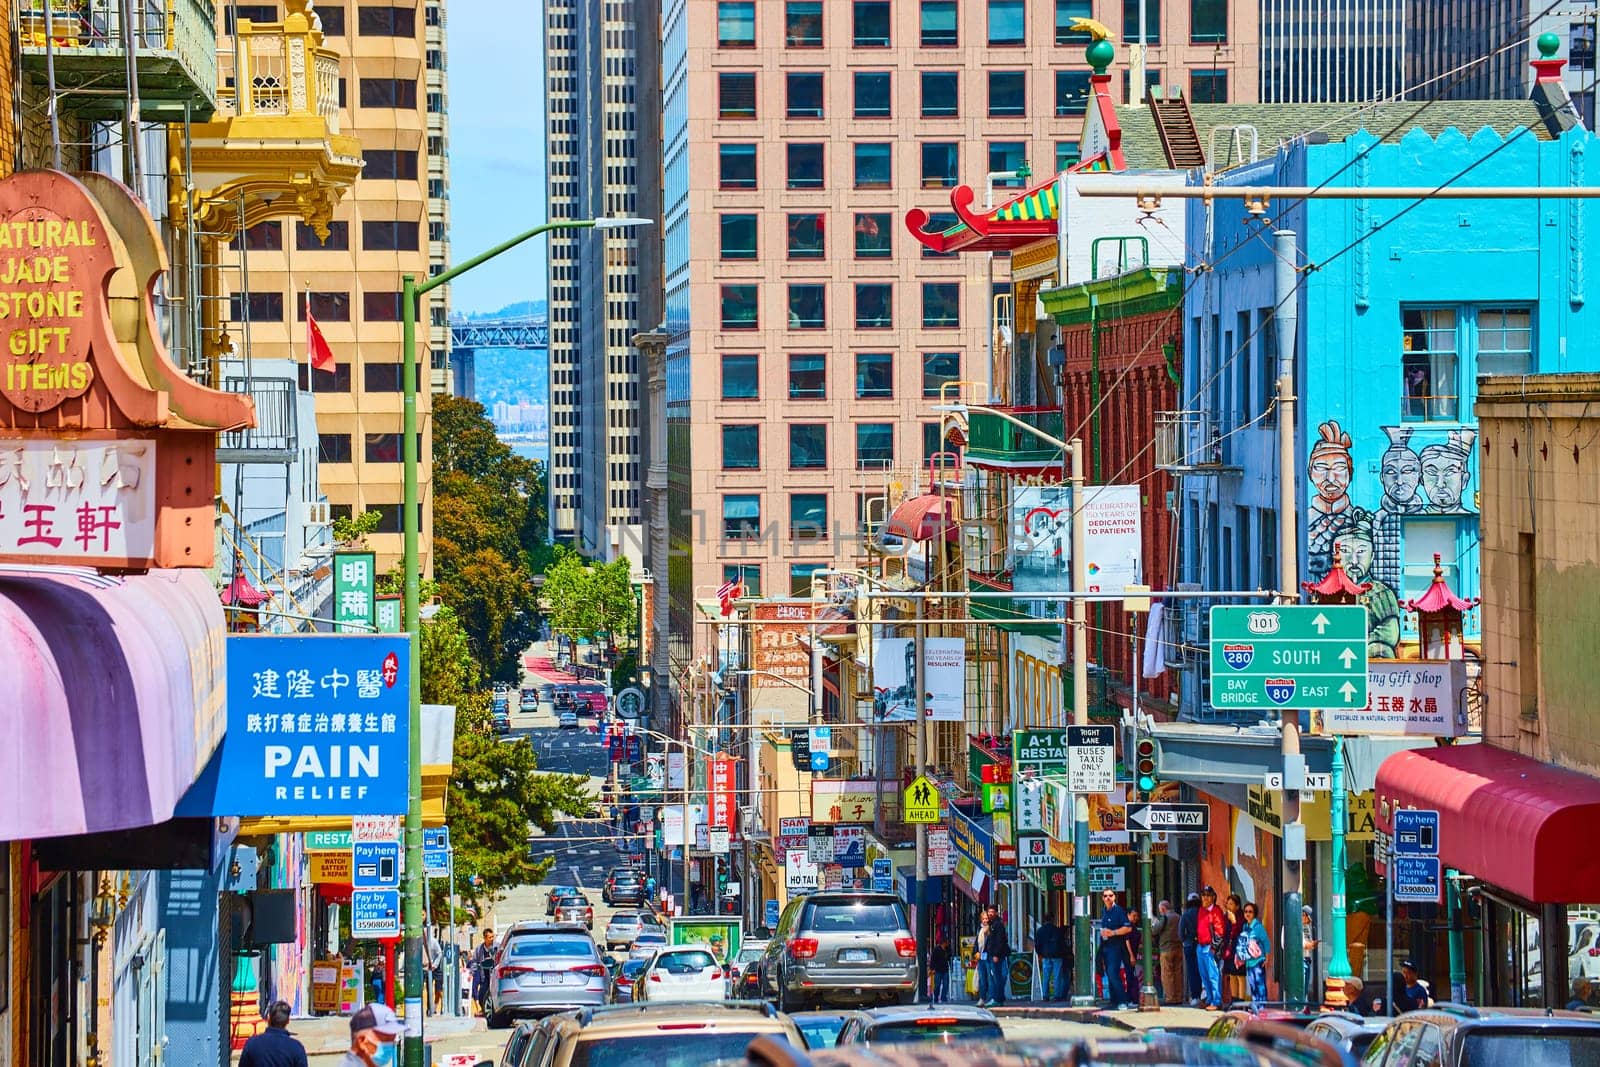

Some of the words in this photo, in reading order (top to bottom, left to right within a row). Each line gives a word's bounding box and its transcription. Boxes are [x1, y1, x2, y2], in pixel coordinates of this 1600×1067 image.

[1, 256, 70, 284] JADE
[0, 291, 83, 318] STONE
[9, 327, 71, 355] GIFT
[7, 362, 87, 391] ITEMS
[0, 501, 121, 552] 玉軒
[1088, 519, 1136, 527] DEDICATION
[1254, 619, 1273, 629] 101
[1228, 653, 1251, 663] 280
[1272, 650, 1320, 664] SOUTH
[252, 668, 384, 698] 建隆中醫
[1389, 670, 1411, 687] Gift
[1414, 671, 1442, 687] Shop
[1228, 680, 1248, 689] BAY
[1221, 693, 1258, 703] BRIDGE
[1273, 689, 1289, 699] 80
[1302, 686, 1329, 697] EAST
[1028, 735, 1052, 746] A-1
[264, 745, 379, 778] PAIN
[1270, 776, 1326, 787] GNT
[276, 786, 368, 799] RELIEF
[1151, 812, 1173, 822] ONE
[1176, 812, 1200, 823] WAY
[1398, 814, 1415, 824] Pay
[1415, 814, 1436, 824] here
[356, 846, 374, 857] Pay
[374, 845, 396, 855] here
[1399, 860, 1412, 869] Pay
[1416, 859, 1426, 869] by
[1399, 868, 1428, 876] License
[790, 876, 800, 884] HO
[356, 894, 371, 903] Pay
[374, 893, 385, 903] by
